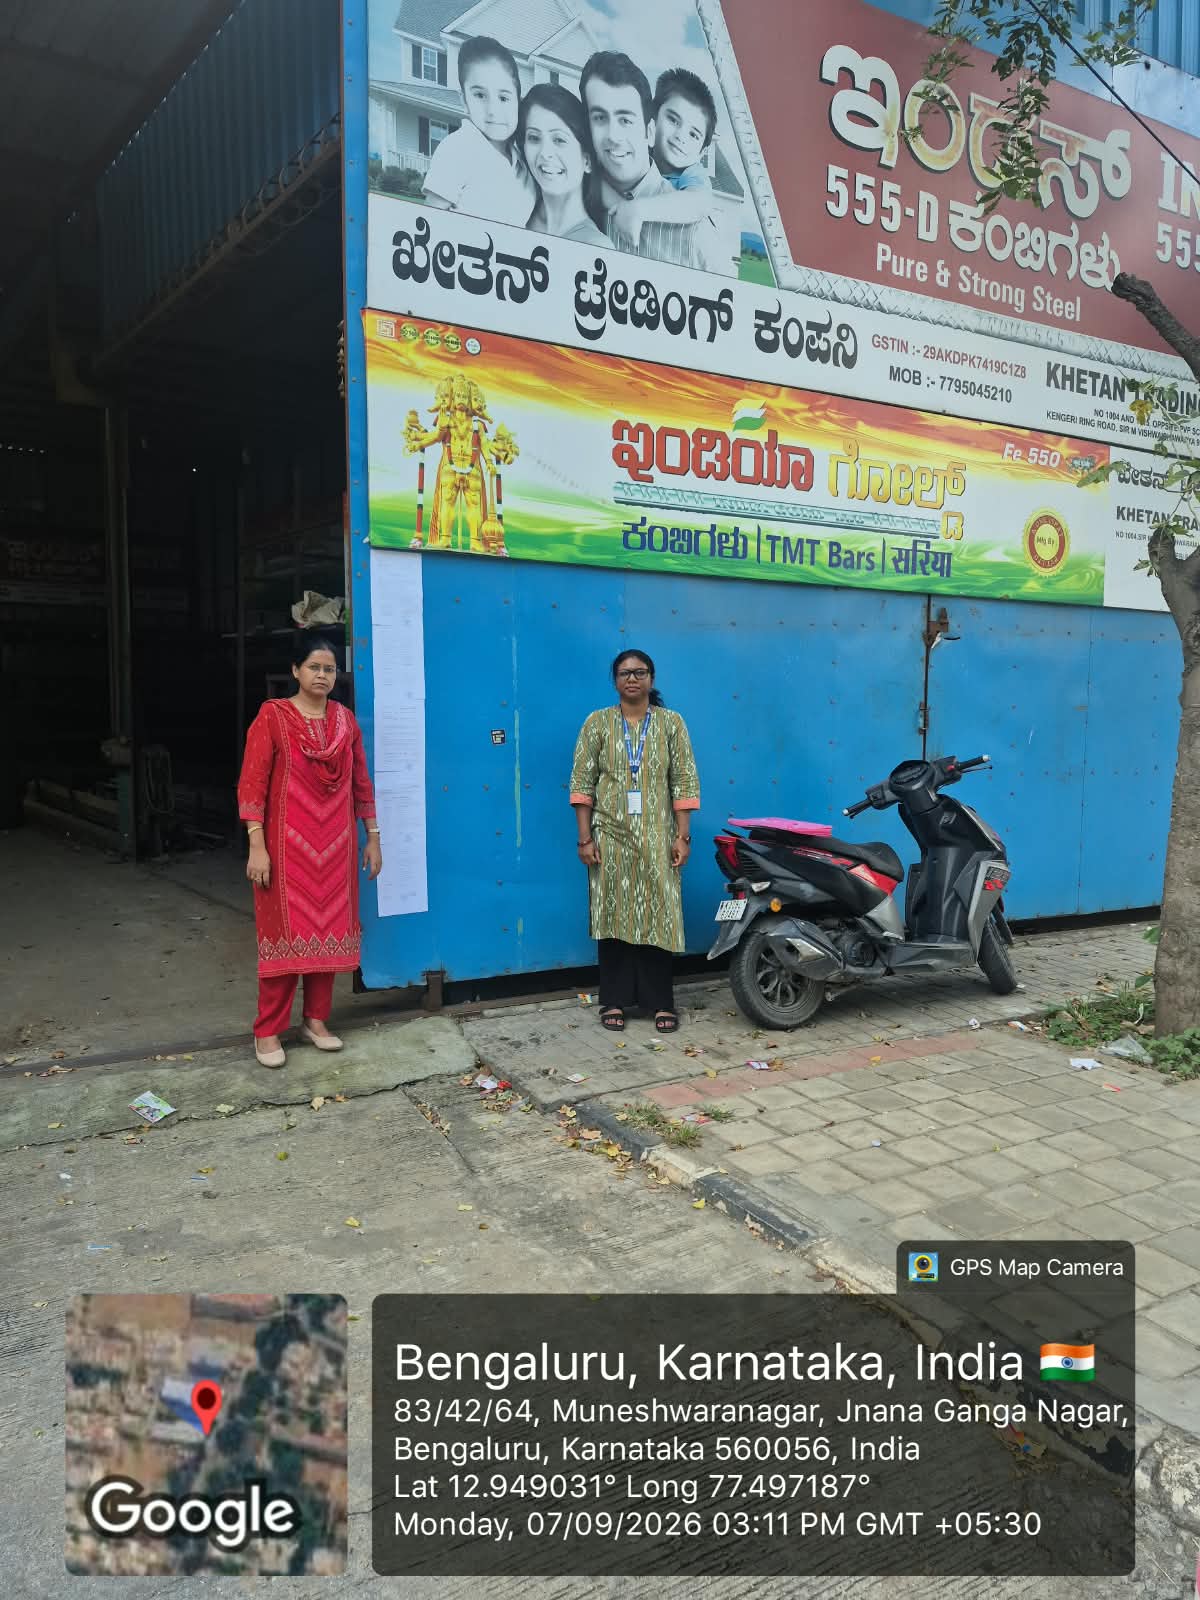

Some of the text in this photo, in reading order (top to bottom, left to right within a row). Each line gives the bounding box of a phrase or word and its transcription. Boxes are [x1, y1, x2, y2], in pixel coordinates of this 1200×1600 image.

[825, 164, 1121, 292] 555-D ಕಂಬಿಗಳು
[392, 216, 858, 369] ಖೇತನ್ ಟ್ರೇಡಿಂಗ್ ಕಂಪನಿ
[876, 243, 1081, 321] Pure & Strong Steel
[872, 333, 909, 354] GSTIN
[923, 344, 1027, 379] 29AKDPK7419C1Z8
[889, 365, 922, 386] MOB
[939, 375, 1012, 404] 7795045210
[1046, 361, 1126, 403] KHETAN
[1046, 409, 1078, 424] KENGERI
[1079, 416, 1096, 428] RING
[1119, 424, 1130, 434] SIR
[1131, 427, 1137, 435] M
[1094, 408, 1104, 418] NO
[1121, 413, 1135, 424] AND
[612, 418, 815, 492] ಇಂಡಿಯಾ
[1002, 441, 1022, 461] Fe
[1028, 447, 1061, 468] 550
[622, 516, 953, 578] ಕಂಬಿಗಳು TMT Bars सरिया
